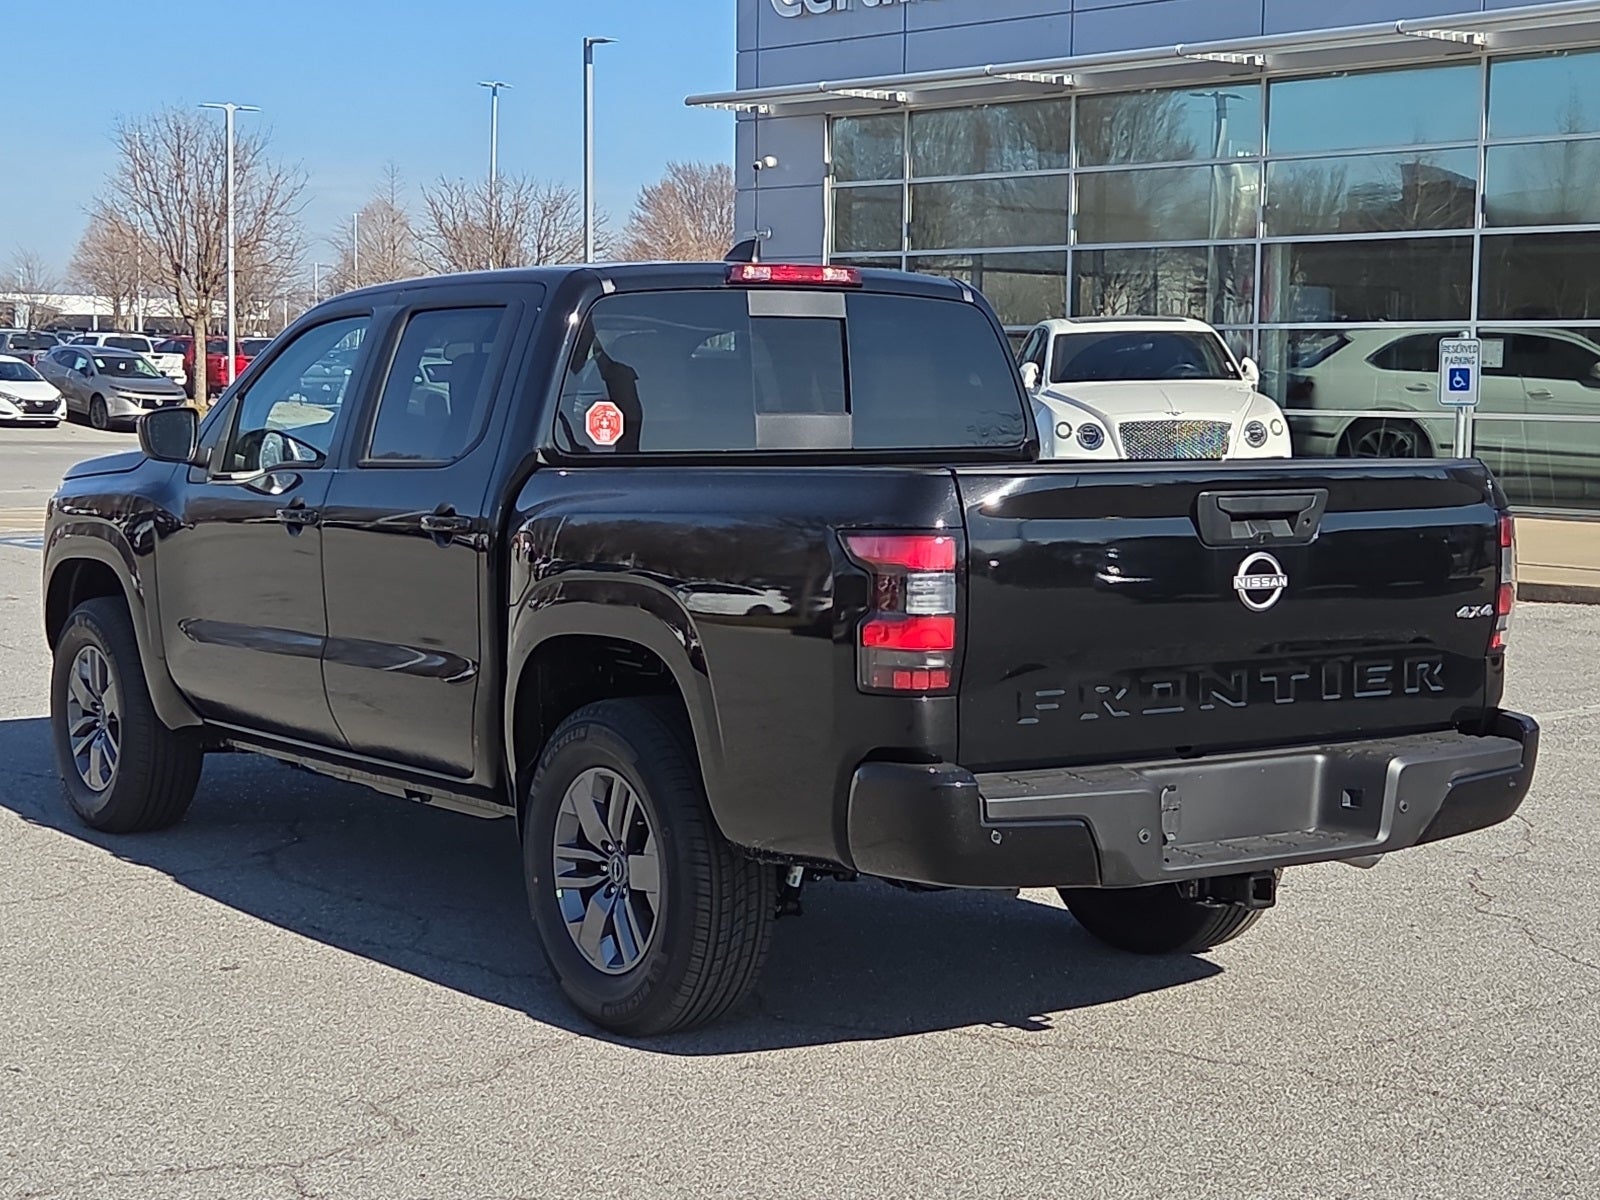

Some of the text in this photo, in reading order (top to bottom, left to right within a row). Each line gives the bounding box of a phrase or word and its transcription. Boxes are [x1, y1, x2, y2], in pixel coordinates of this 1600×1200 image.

[1444, 356, 1476, 365] PARKING
[1235, 576, 1287, 588] NISSAN
[1016, 655, 1446, 725] FRONTIER
